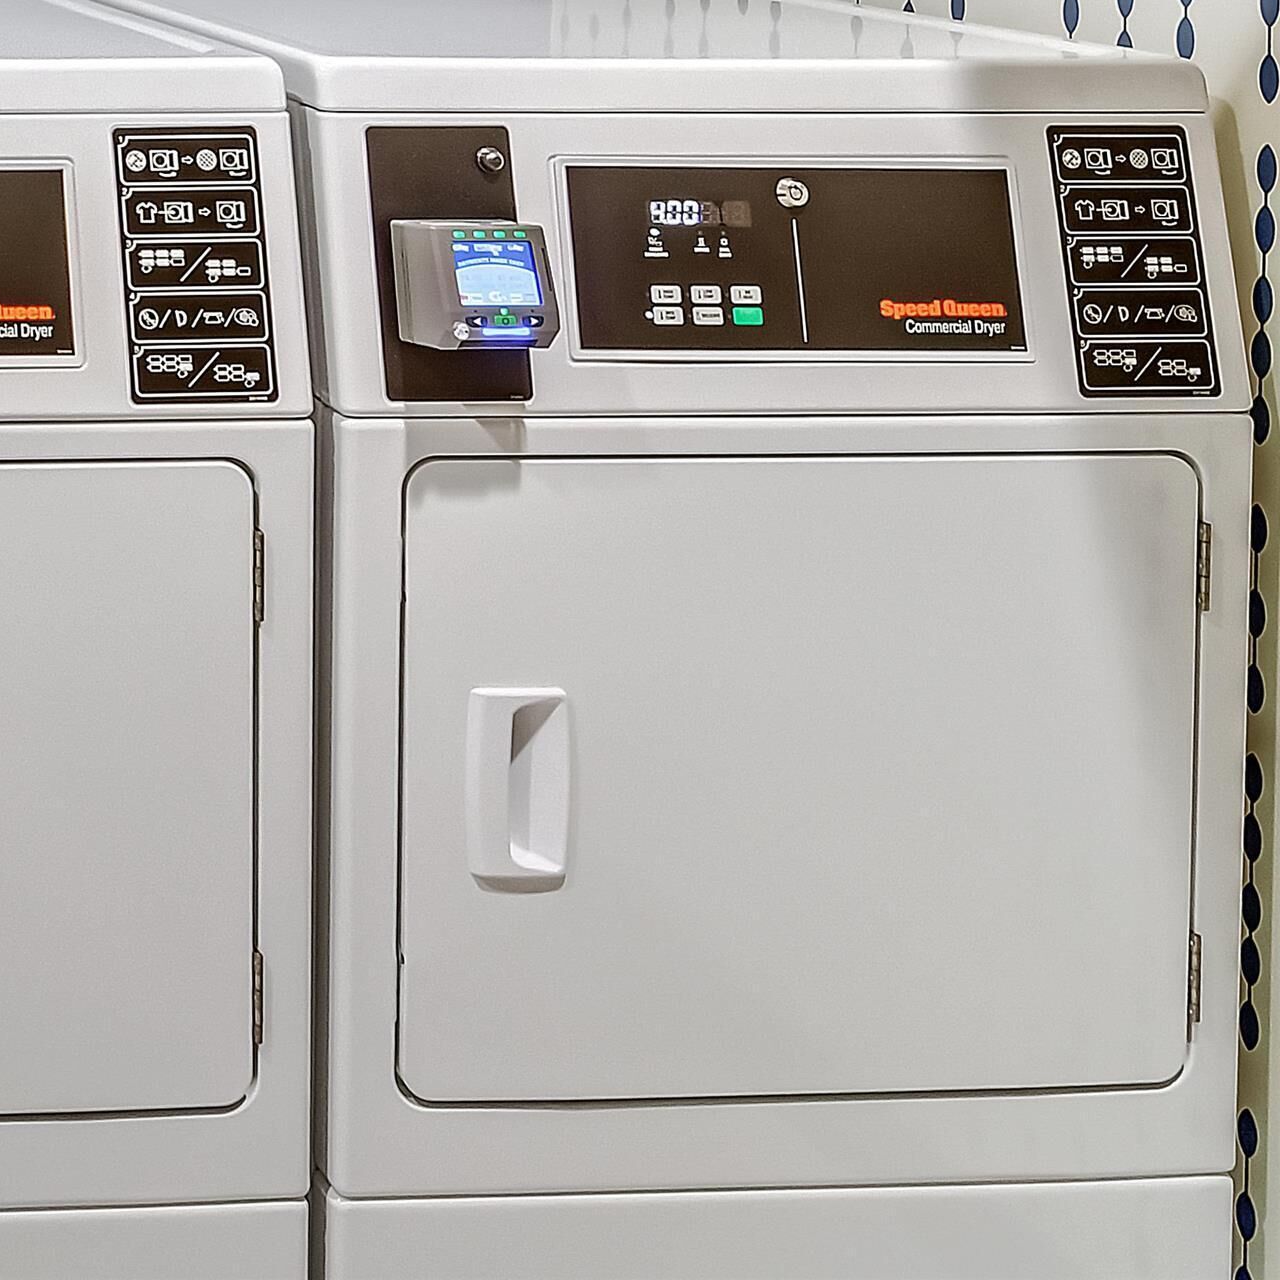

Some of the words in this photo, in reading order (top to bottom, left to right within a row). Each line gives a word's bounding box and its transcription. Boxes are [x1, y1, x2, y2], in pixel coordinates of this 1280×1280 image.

[880, 299, 941, 320] Speed
[20, 323, 54, 341] Dryer
[905, 320, 972, 334] Commercial
[974, 320, 1006, 337] Dryer
